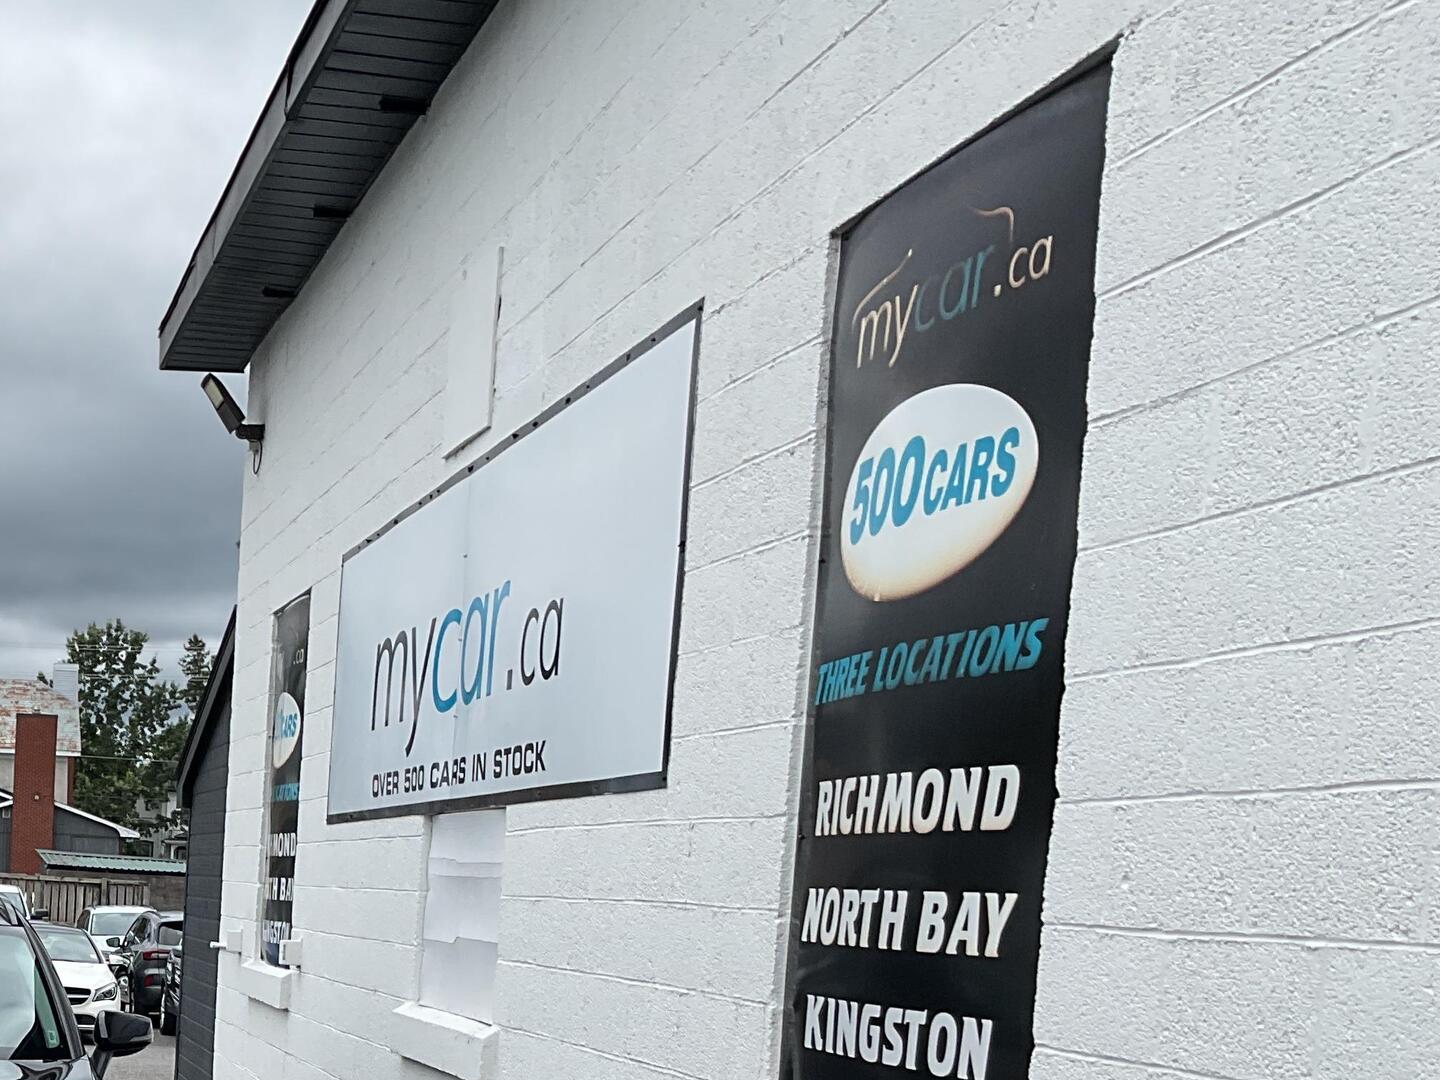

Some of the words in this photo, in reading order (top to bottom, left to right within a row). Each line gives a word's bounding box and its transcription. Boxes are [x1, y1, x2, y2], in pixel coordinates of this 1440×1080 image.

[855, 235, 1054, 368] mycar.ca
[370, 580, 564, 758] mycar.ca
[815, 649, 870, 706] THREE
[872, 617, 1049, 694] LOCATIONS
[371, 769, 399, 798] OVER
[403, 765, 425, 793] 500
[429, 756, 466, 789] CARS
[471, 752, 487, 782] IN
[493, 740, 547, 779] STOCK
[814, 764, 1021, 837] RICHMOND
[800, 887, 908, 951] NORTH
[915, 890, 1018, 958] BAY
